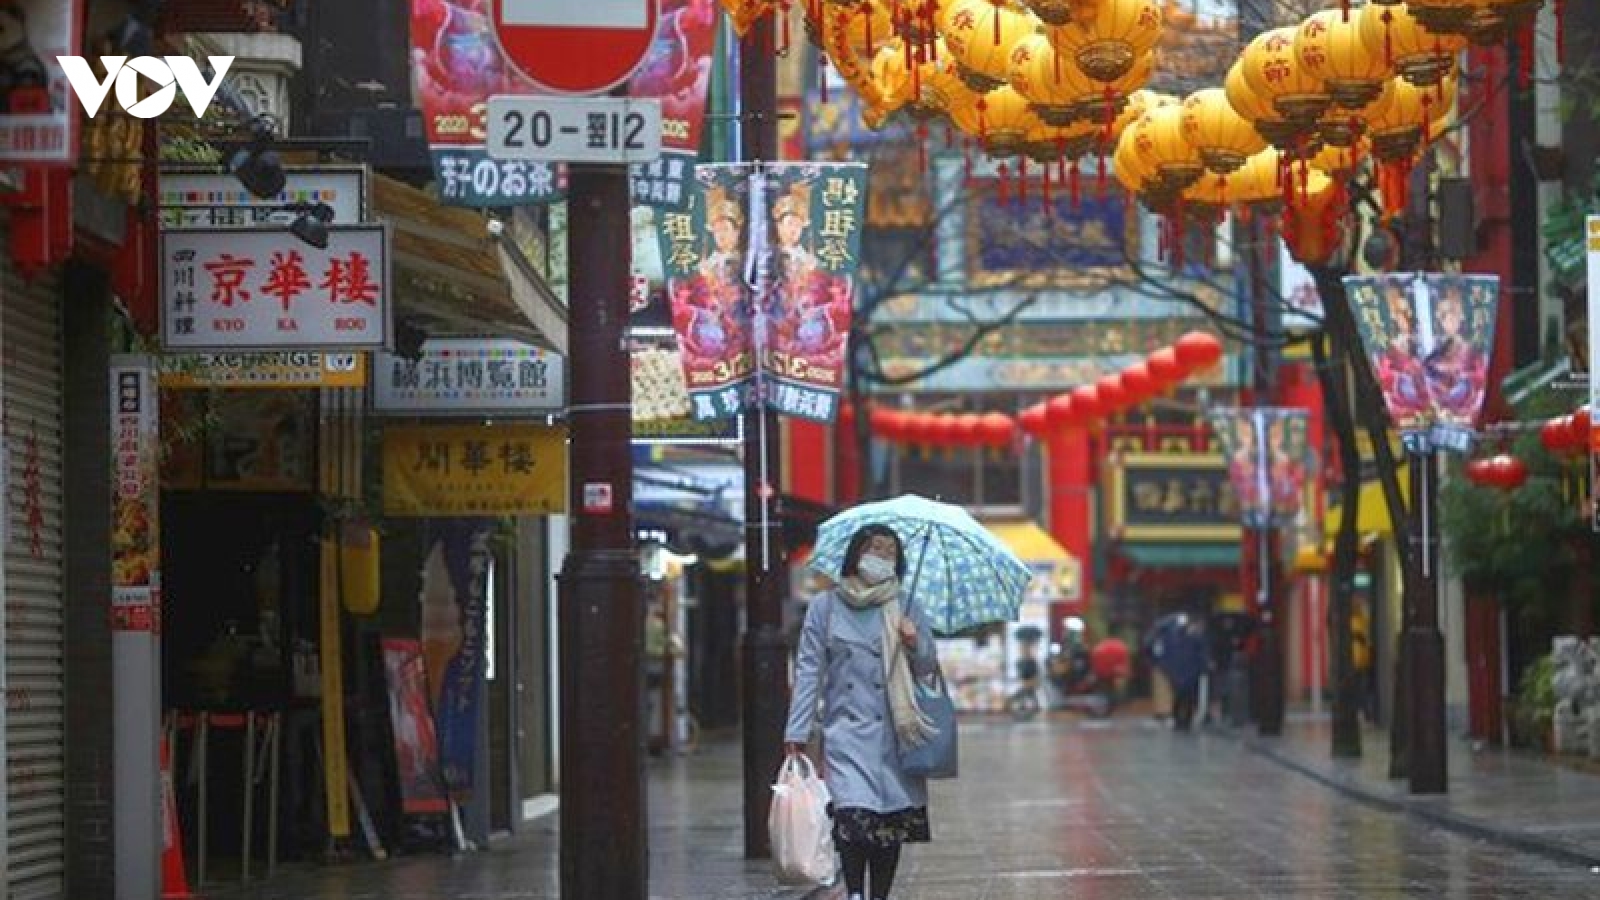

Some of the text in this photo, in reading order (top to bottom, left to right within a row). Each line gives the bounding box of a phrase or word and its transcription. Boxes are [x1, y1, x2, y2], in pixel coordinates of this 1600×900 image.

[663, 195, 700, 272] 祖祭
[213, 318, 245, 332] KYO
[277, 318, 298, 332] KA
